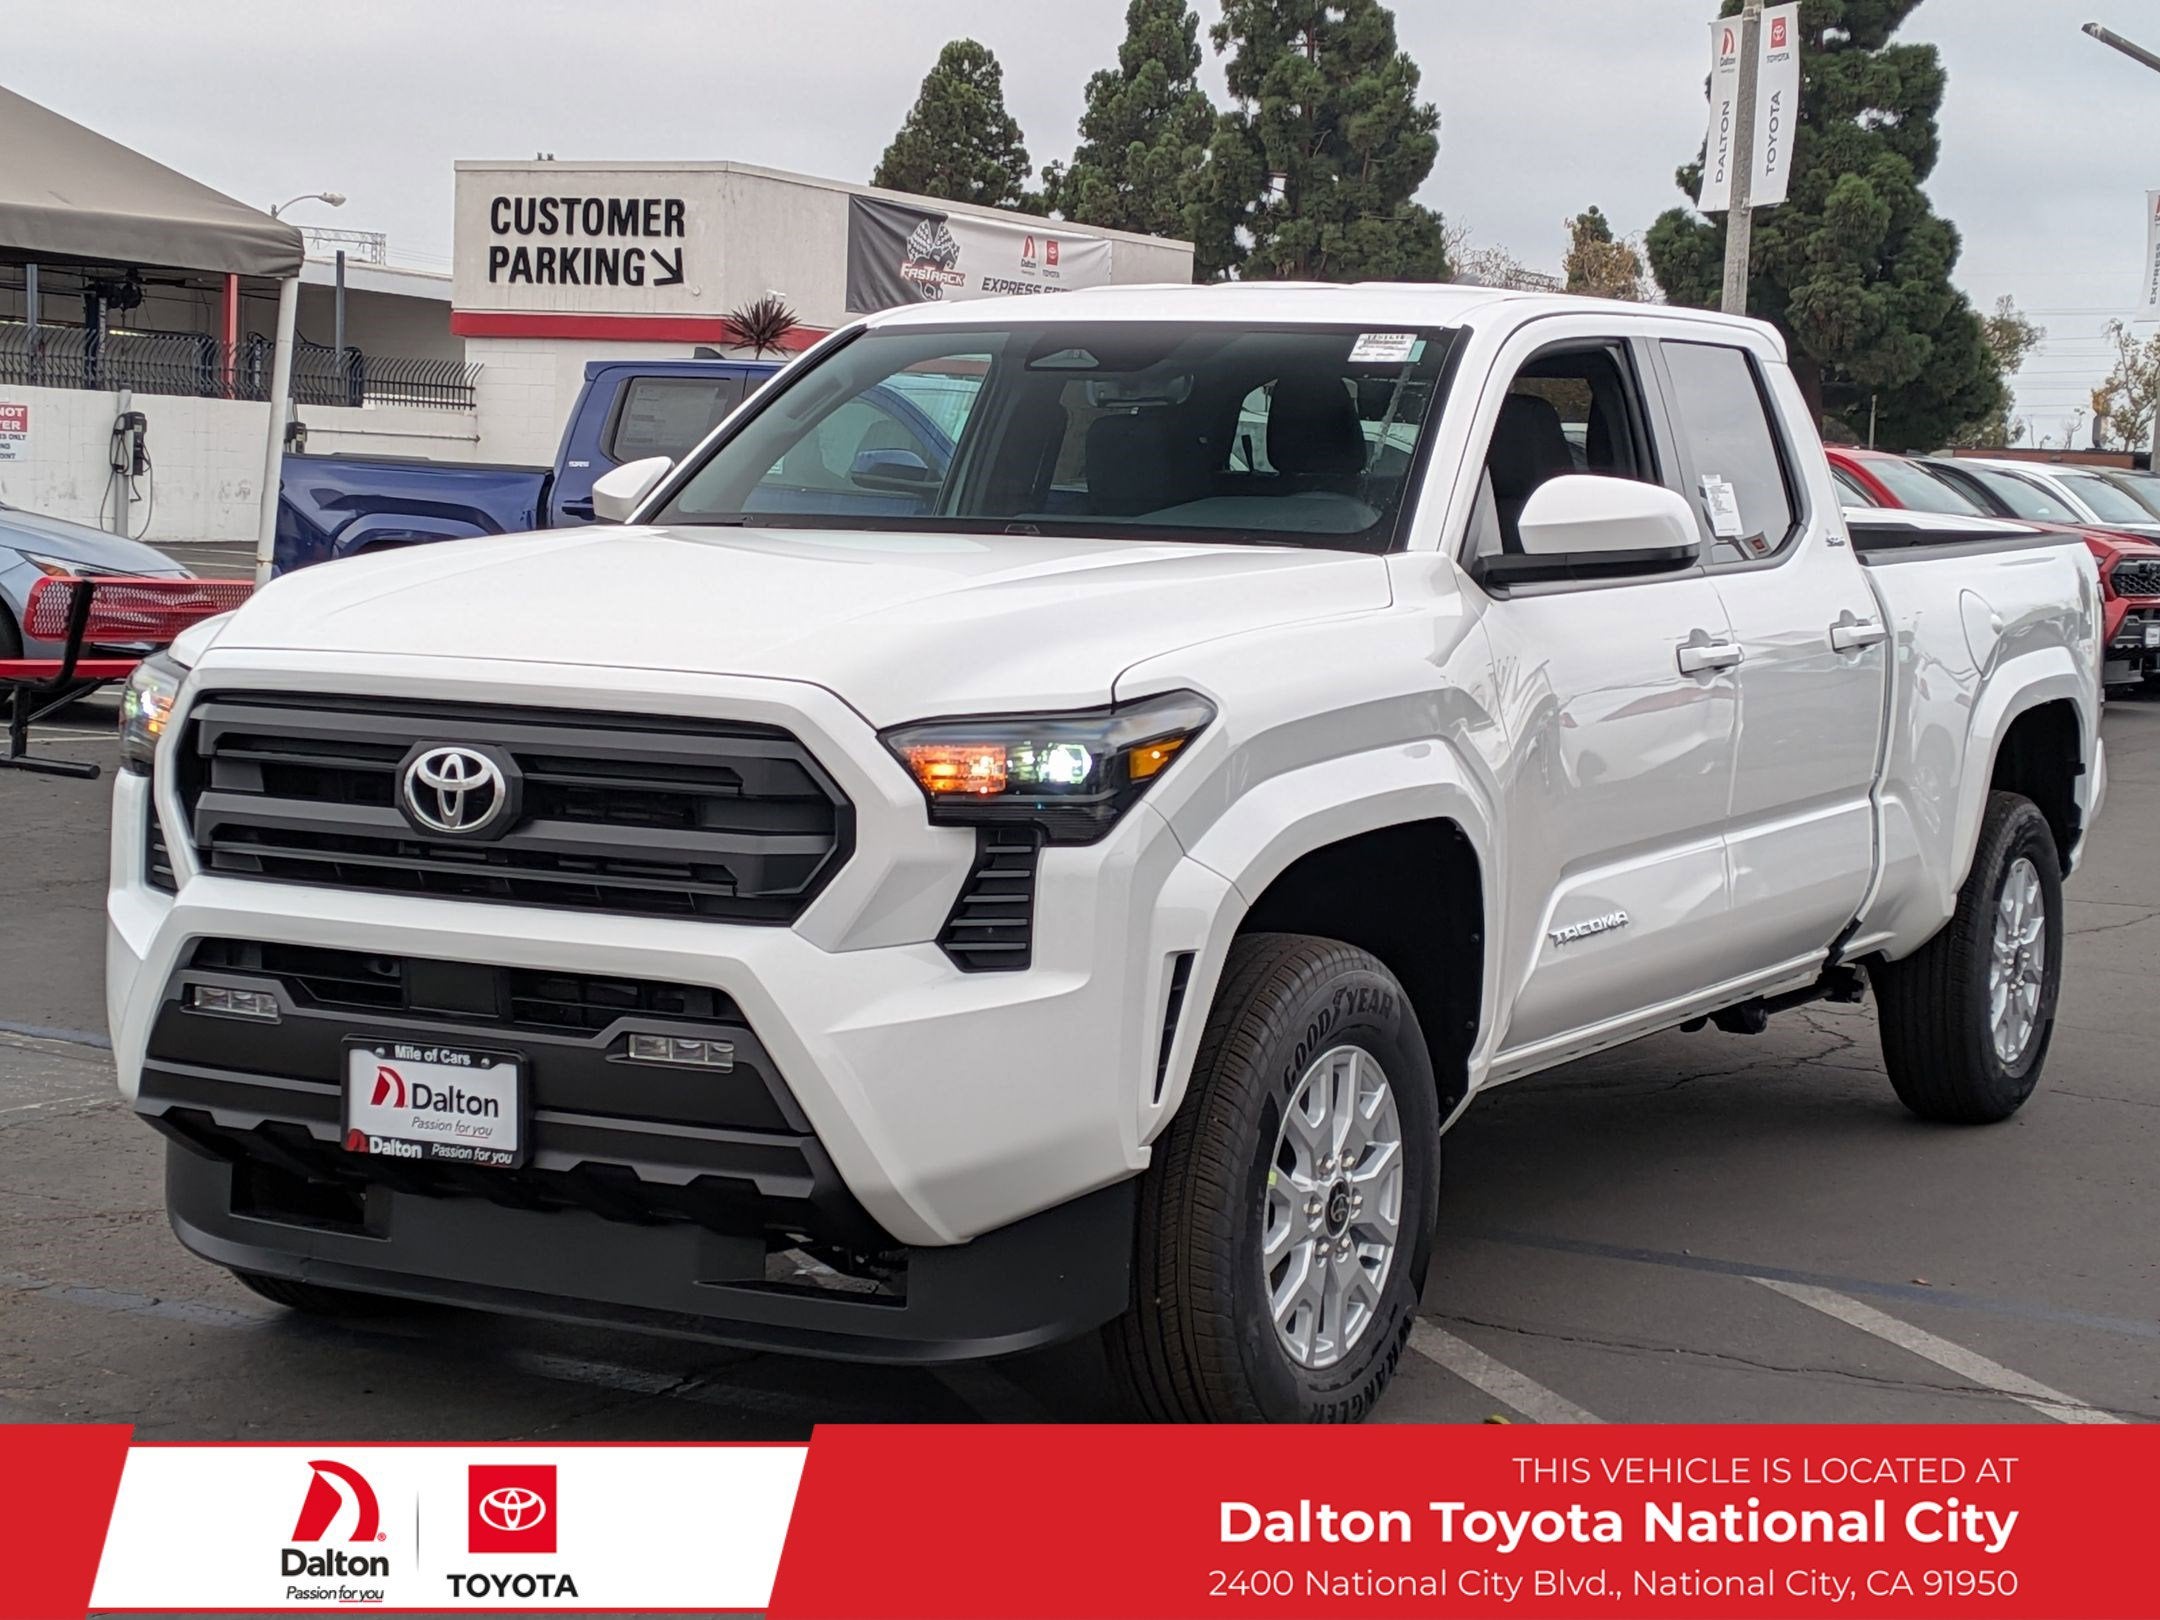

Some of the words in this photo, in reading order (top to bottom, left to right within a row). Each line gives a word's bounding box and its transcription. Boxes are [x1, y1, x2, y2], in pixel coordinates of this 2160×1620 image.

[1715, 100, 1730, 183] DALTON
[1765, 90, 1781, 176] TOYOTA
[490, 196, 686, 237] CUSTOMER
[489, 245, 646, 286] PARKING
[981, 276, 1042, 295] EXPRESS
[0, 421, 21, 431] ER
[1548, 910, 1629, 947] TACOMA
[394, 1045, 421, 1061] Mile
[424, 1048, 438, 1062] of
[440, 1049, 471, 1066] Cars
[1283, 985, 1393, 1095] GOODYEAR
[412, 1083, 499, 1118] Dalton
[411, 1116, 452, 1131] Passion
[454, 1119, 471, 1134] for
[472, 1126, 493, 1137] you
[369, 1136, 423, 1159] Dalton
[431, 1143, 473, 1160] Passion
[474, 1147, 490, 1162] for
[491, 1151, 513, 1165] you
